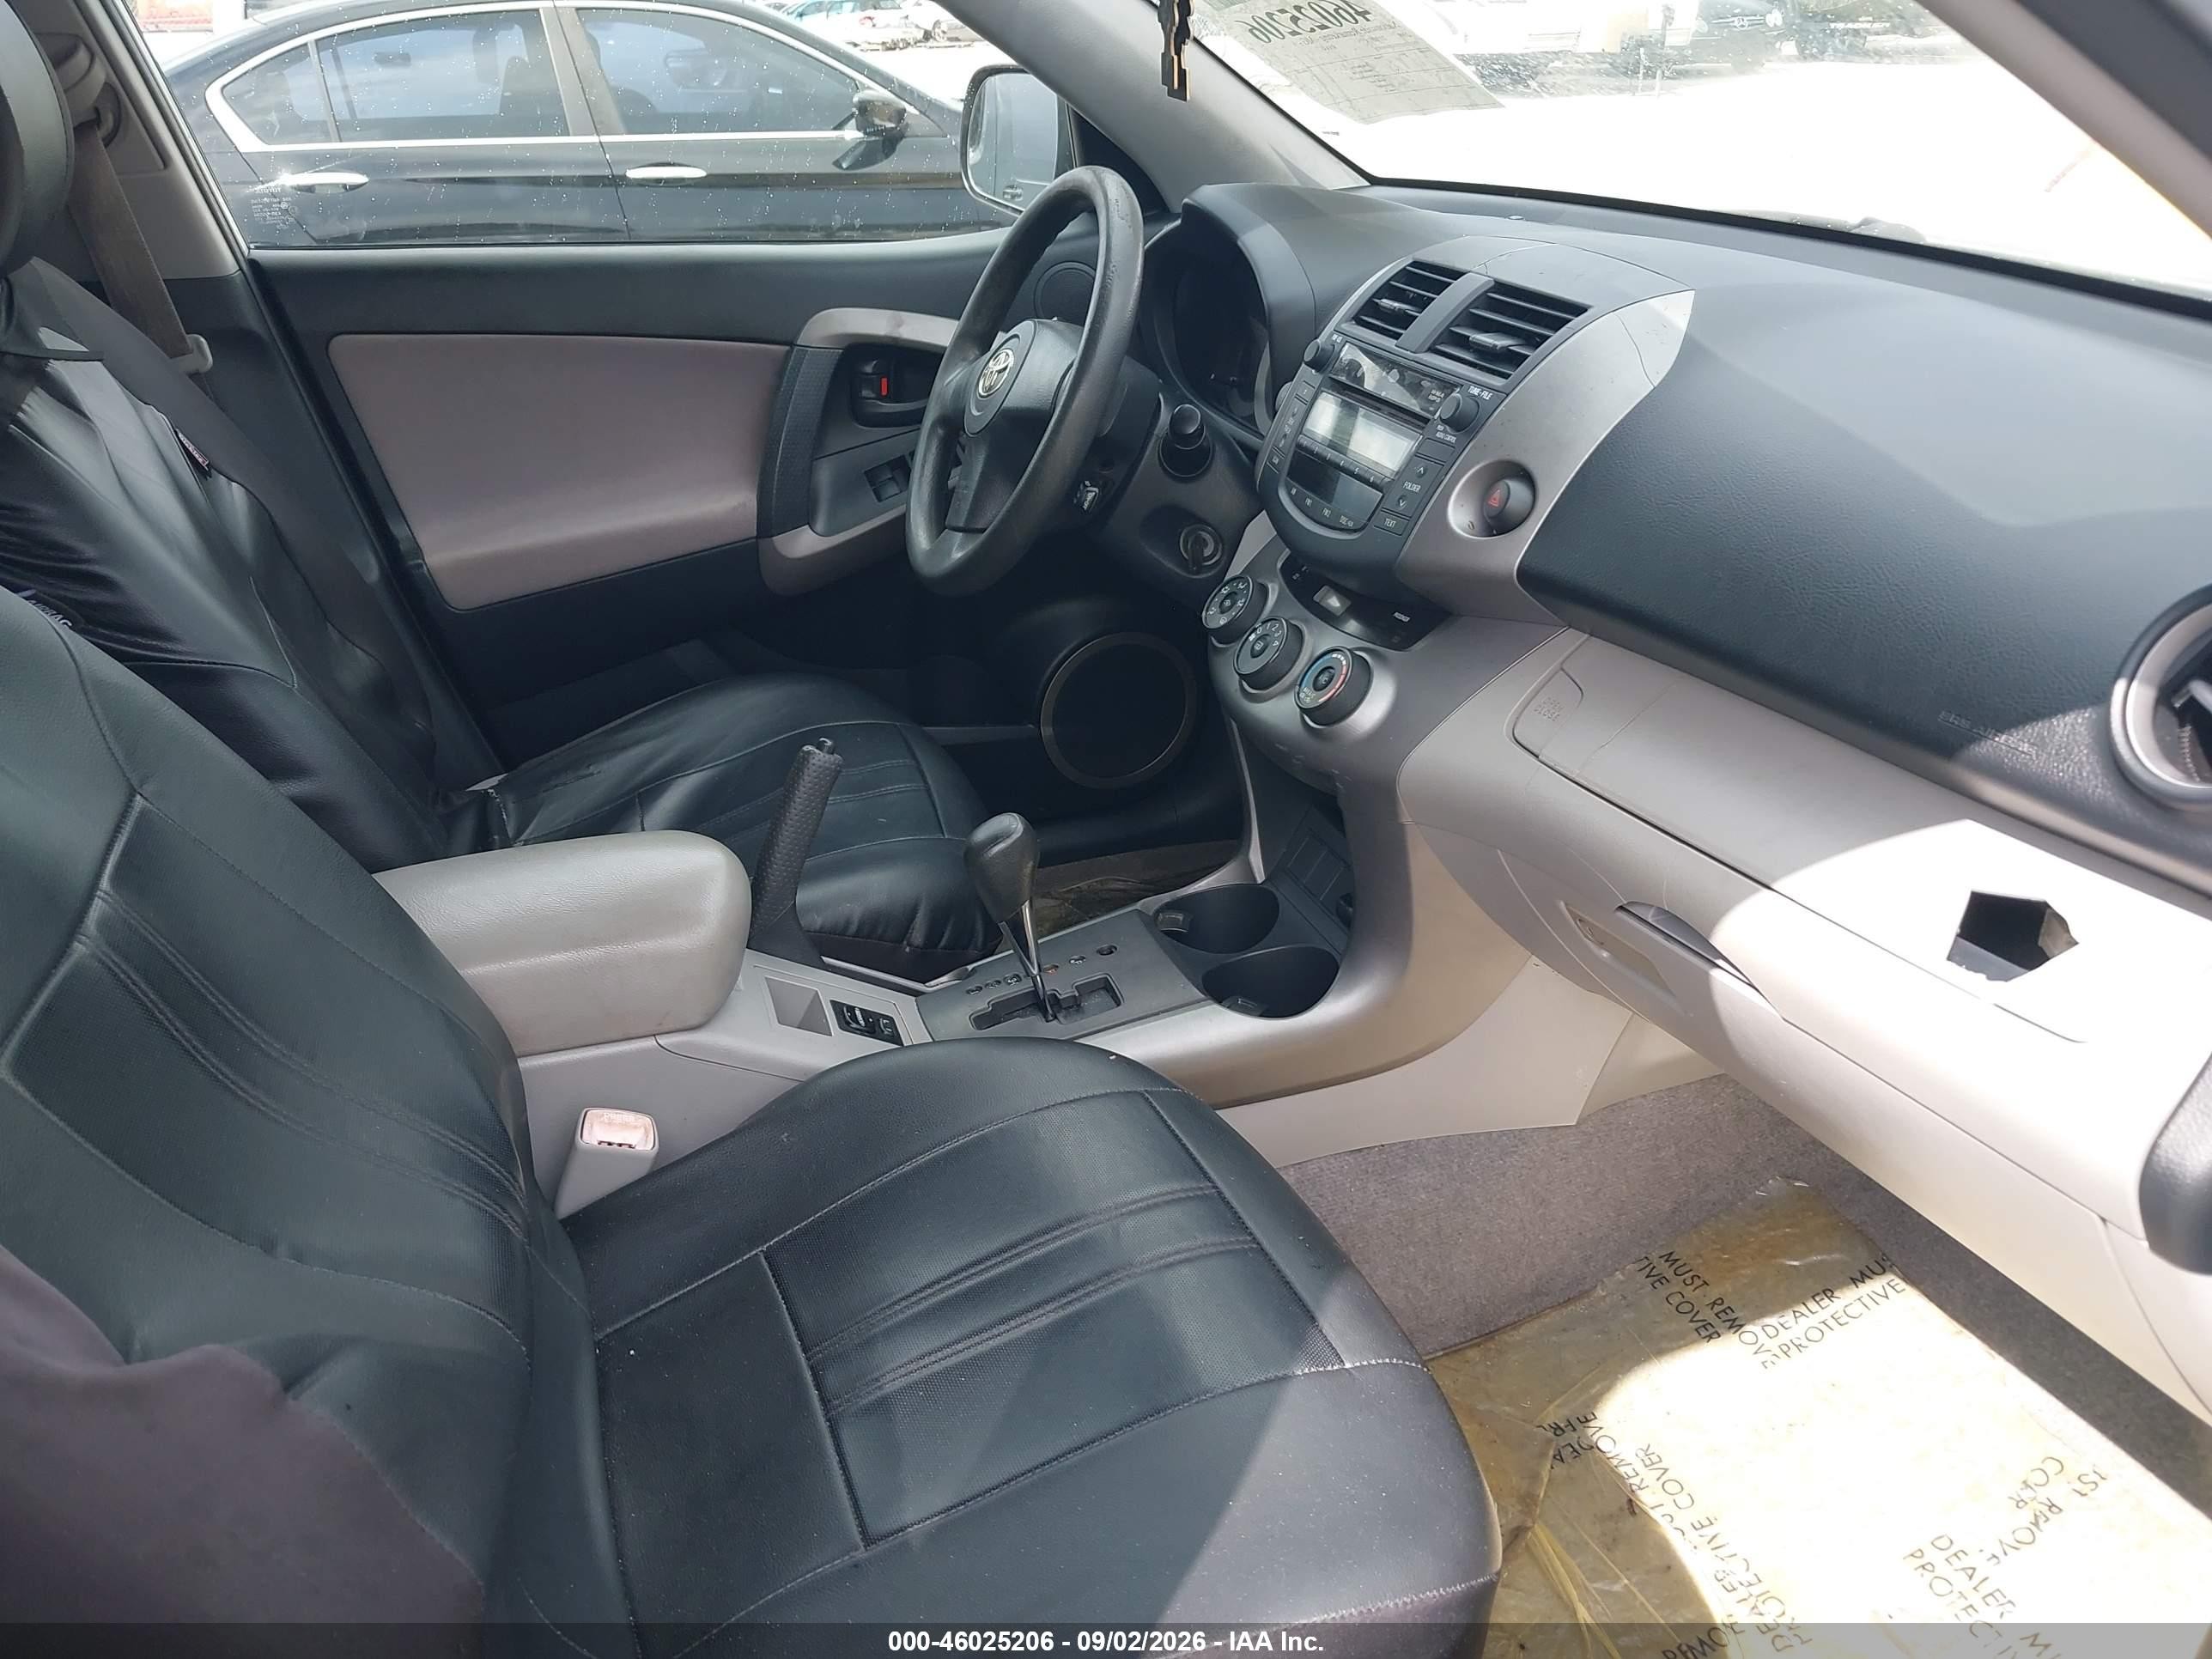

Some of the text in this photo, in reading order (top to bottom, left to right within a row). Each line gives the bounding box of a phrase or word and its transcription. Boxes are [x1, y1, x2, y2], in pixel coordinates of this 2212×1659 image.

[1403, 481, 1421, 493] FOLDER
[1384, 518, 1396, 528] TEXT
[1658, 1250, 1710, 1292] MUST
[1665, 1291, 1722, 1343] COVER
[1761, 1288, 1841, 1340] DEALER
[1778, 1278, 1906, 1358] PROTECTIVE
[1635, 1443, 1694, 1510] COVER
[1930, 1534, 2016, 1620] DEALER
